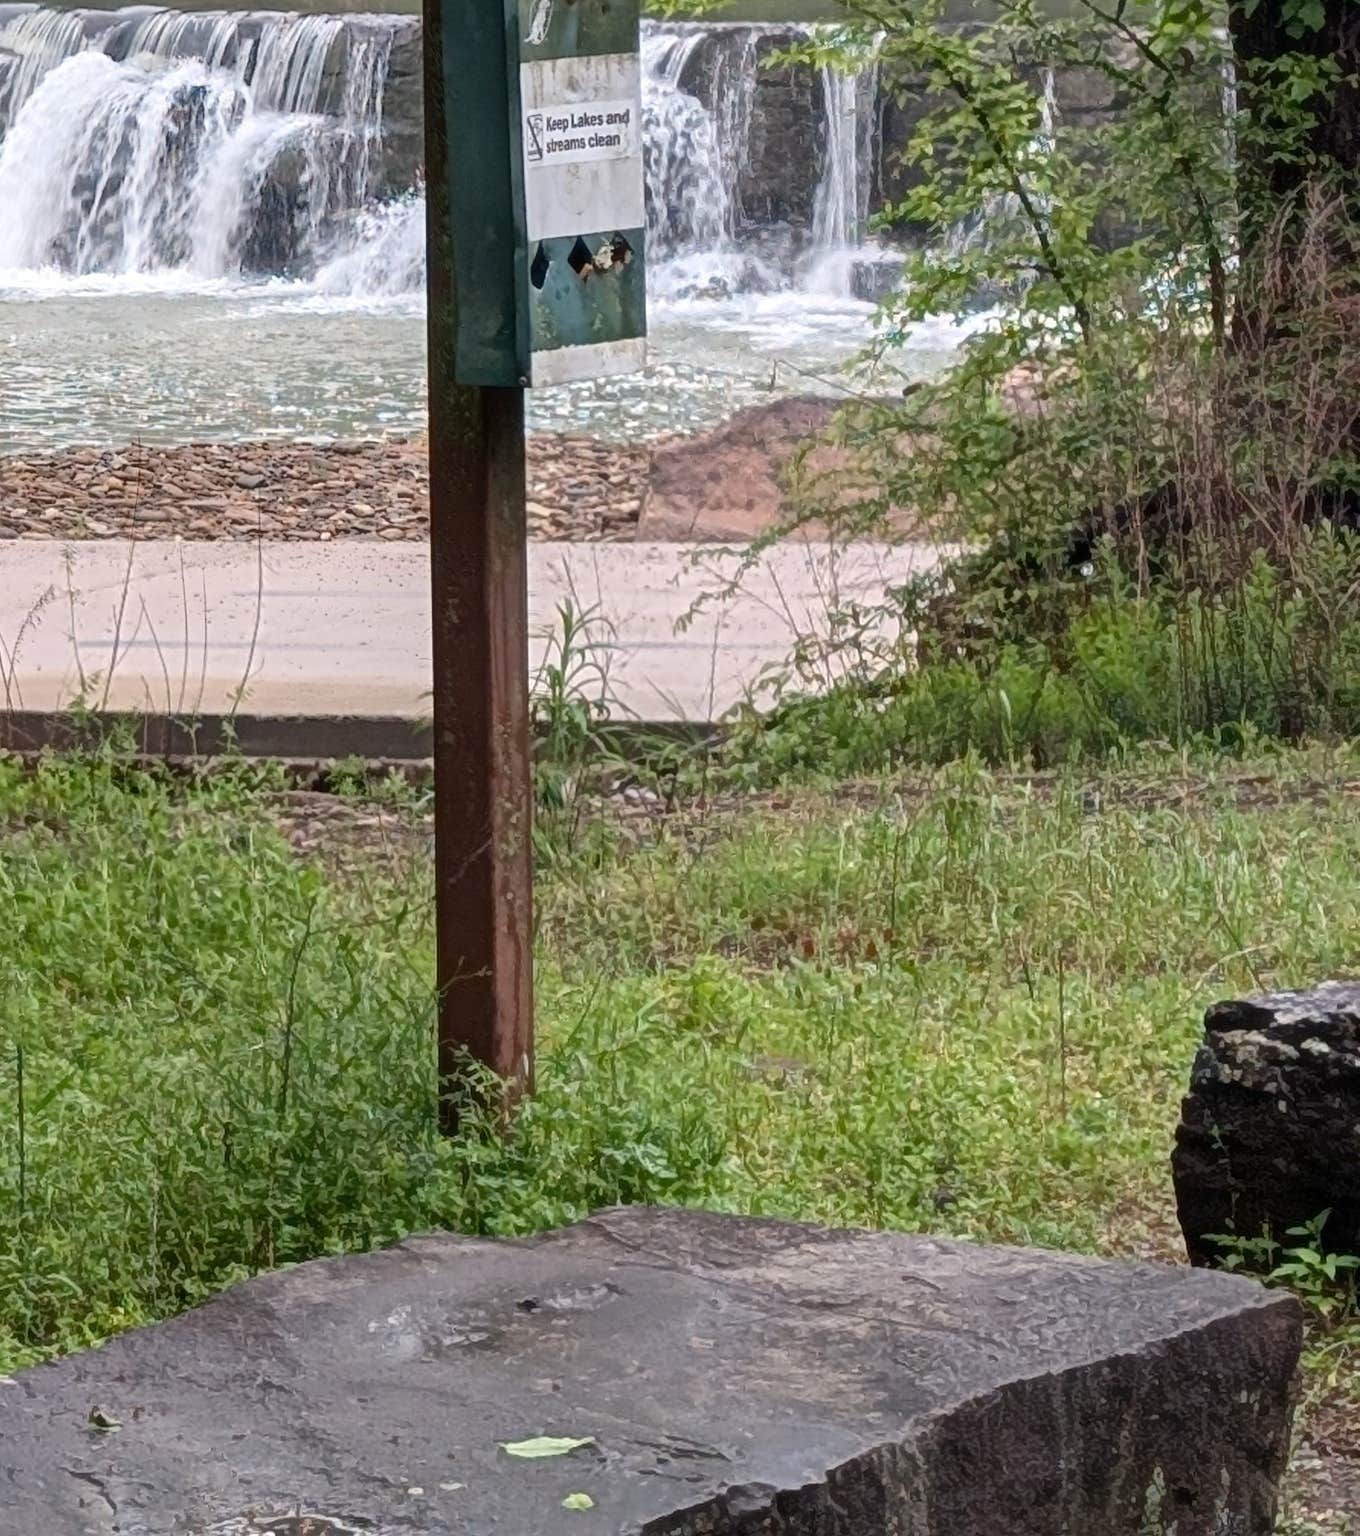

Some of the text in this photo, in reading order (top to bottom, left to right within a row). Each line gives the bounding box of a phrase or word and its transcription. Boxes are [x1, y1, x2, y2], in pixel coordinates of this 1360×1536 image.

[545, 109, 630, 133] Keep Lakes and
[546, 133, 620, 154] streams clean
